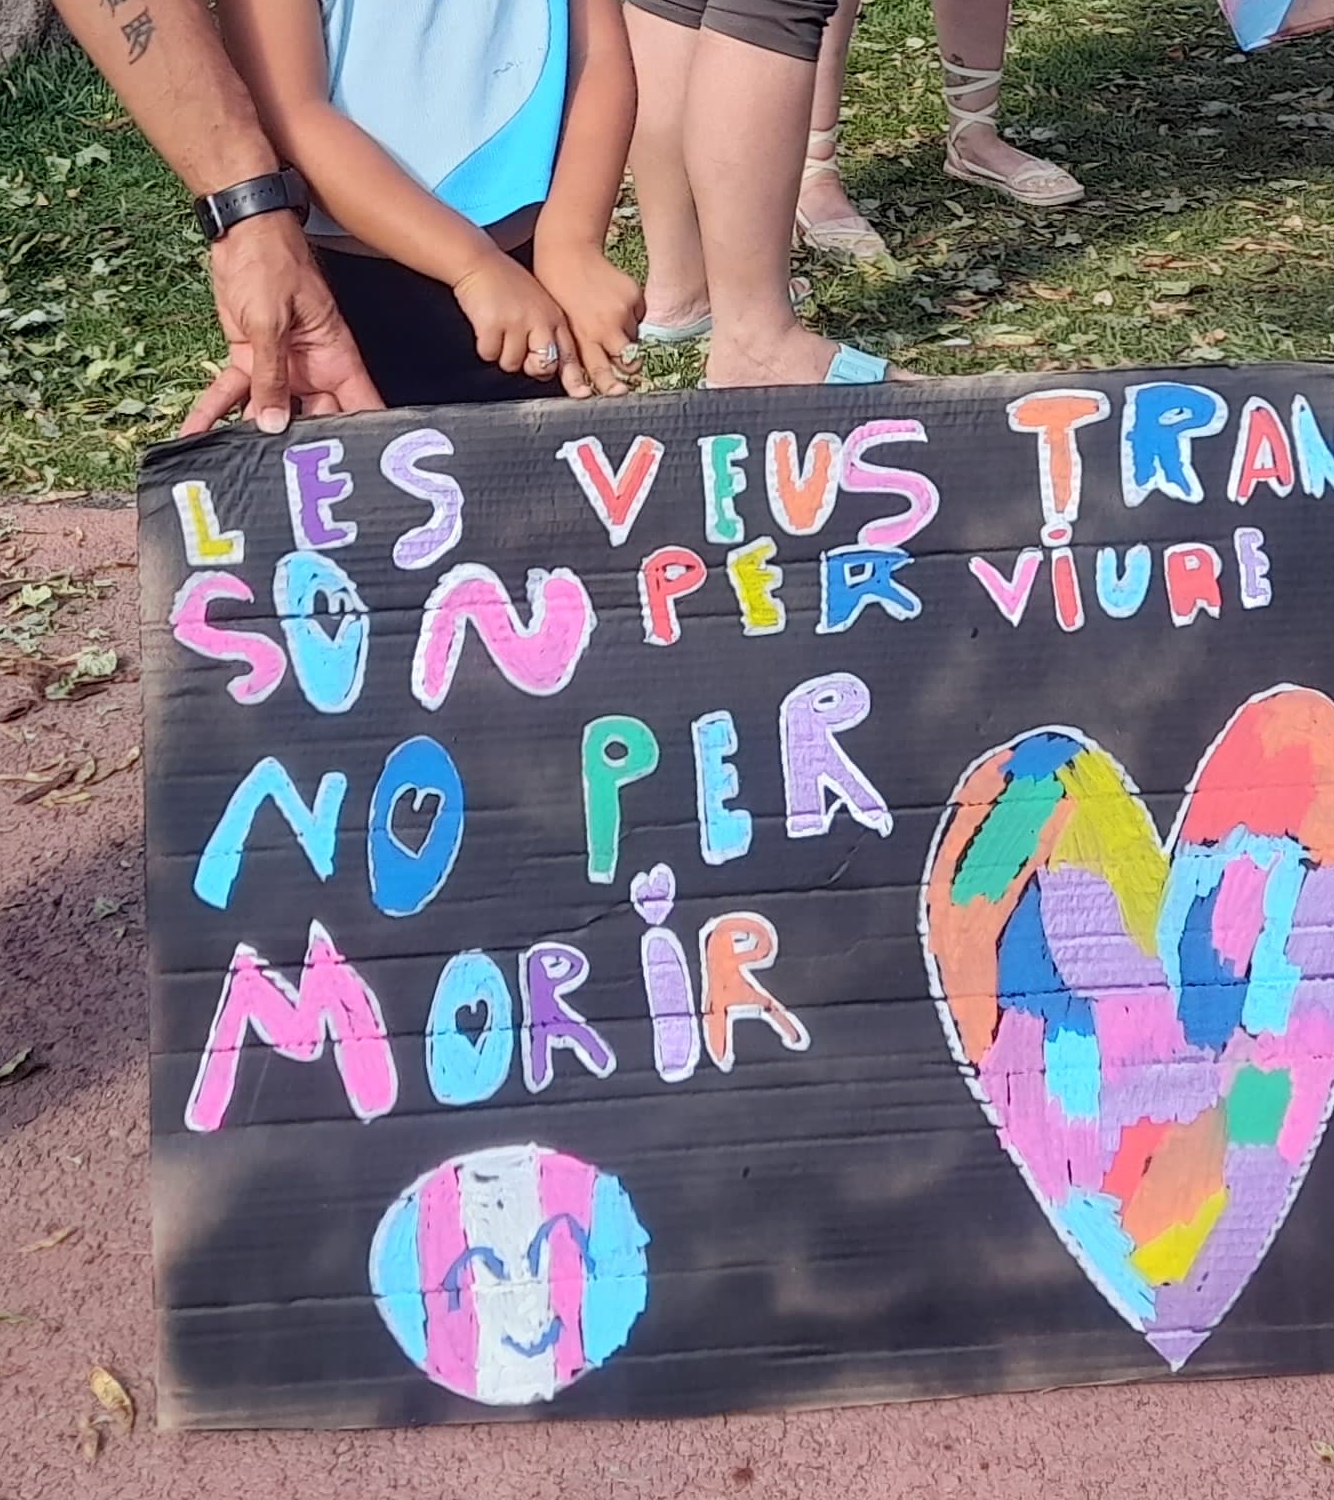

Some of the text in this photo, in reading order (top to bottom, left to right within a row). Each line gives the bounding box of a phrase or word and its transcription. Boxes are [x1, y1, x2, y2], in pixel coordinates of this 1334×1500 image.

[172, 427, 465, 570] LES
[555, 419, 940, 548] VEUS
[169, 550, 598, 714] SON
[640, 536, 922, 646] PER
[192, 672, 893, 917] NO PER
